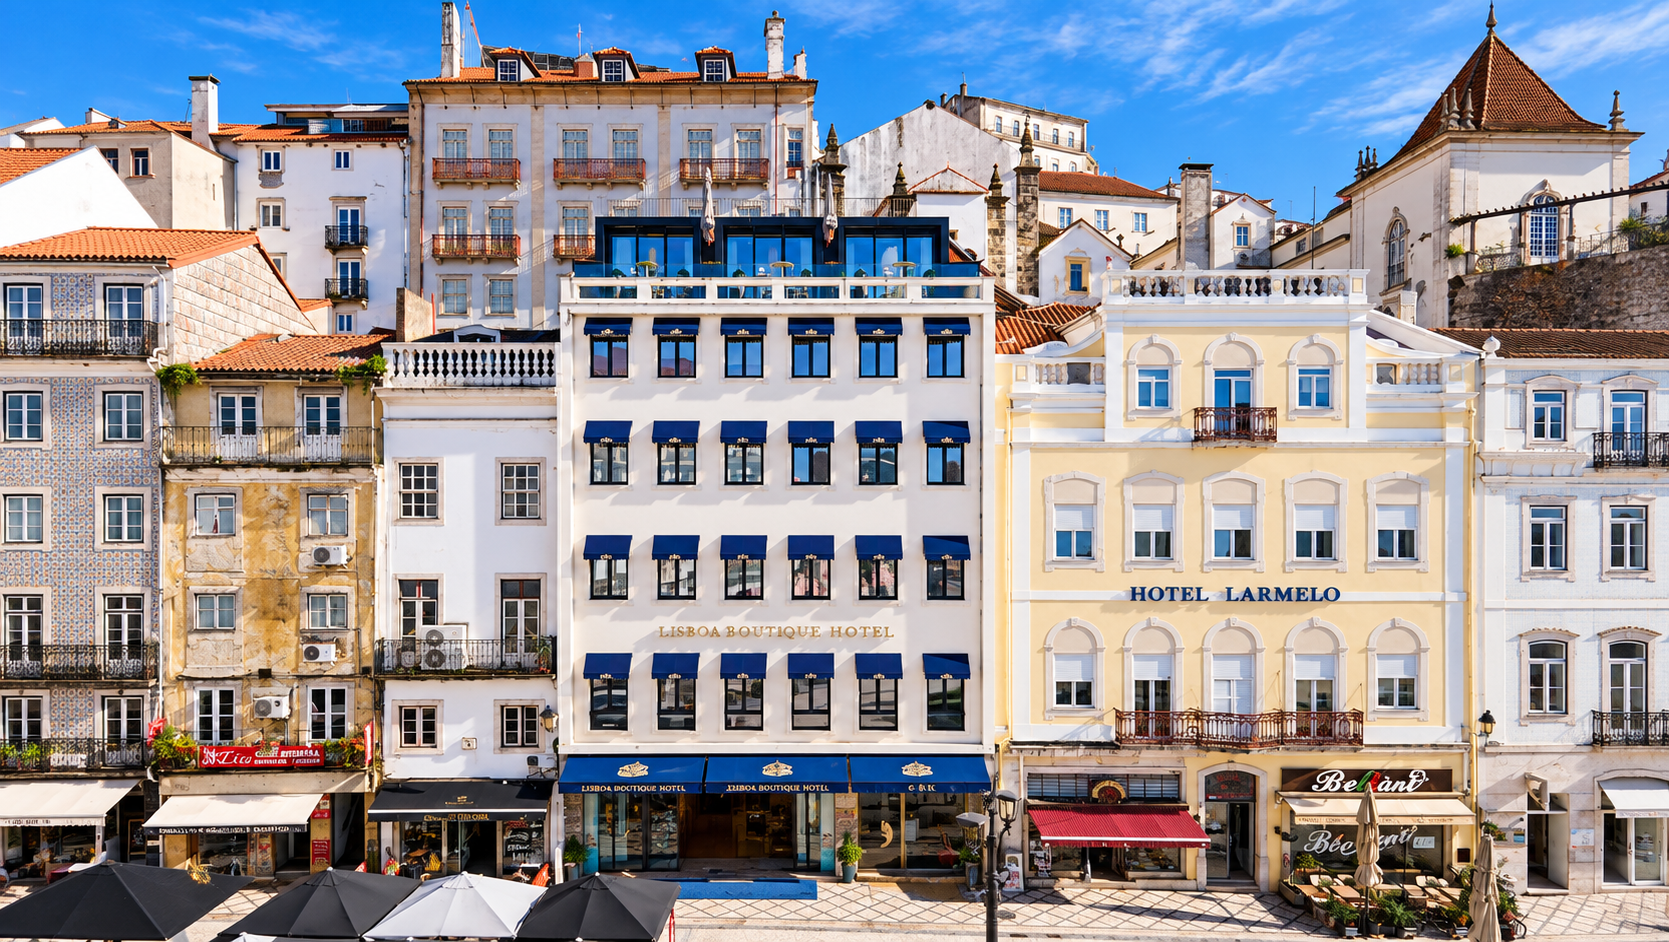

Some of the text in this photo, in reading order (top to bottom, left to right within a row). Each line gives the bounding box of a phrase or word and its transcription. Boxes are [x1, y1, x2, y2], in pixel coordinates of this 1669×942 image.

[1130, 586, 1341, 602] HOTEL LARMELO
[658, 626, 895, 640] LISBOA BOUTIQUE HOTEL
